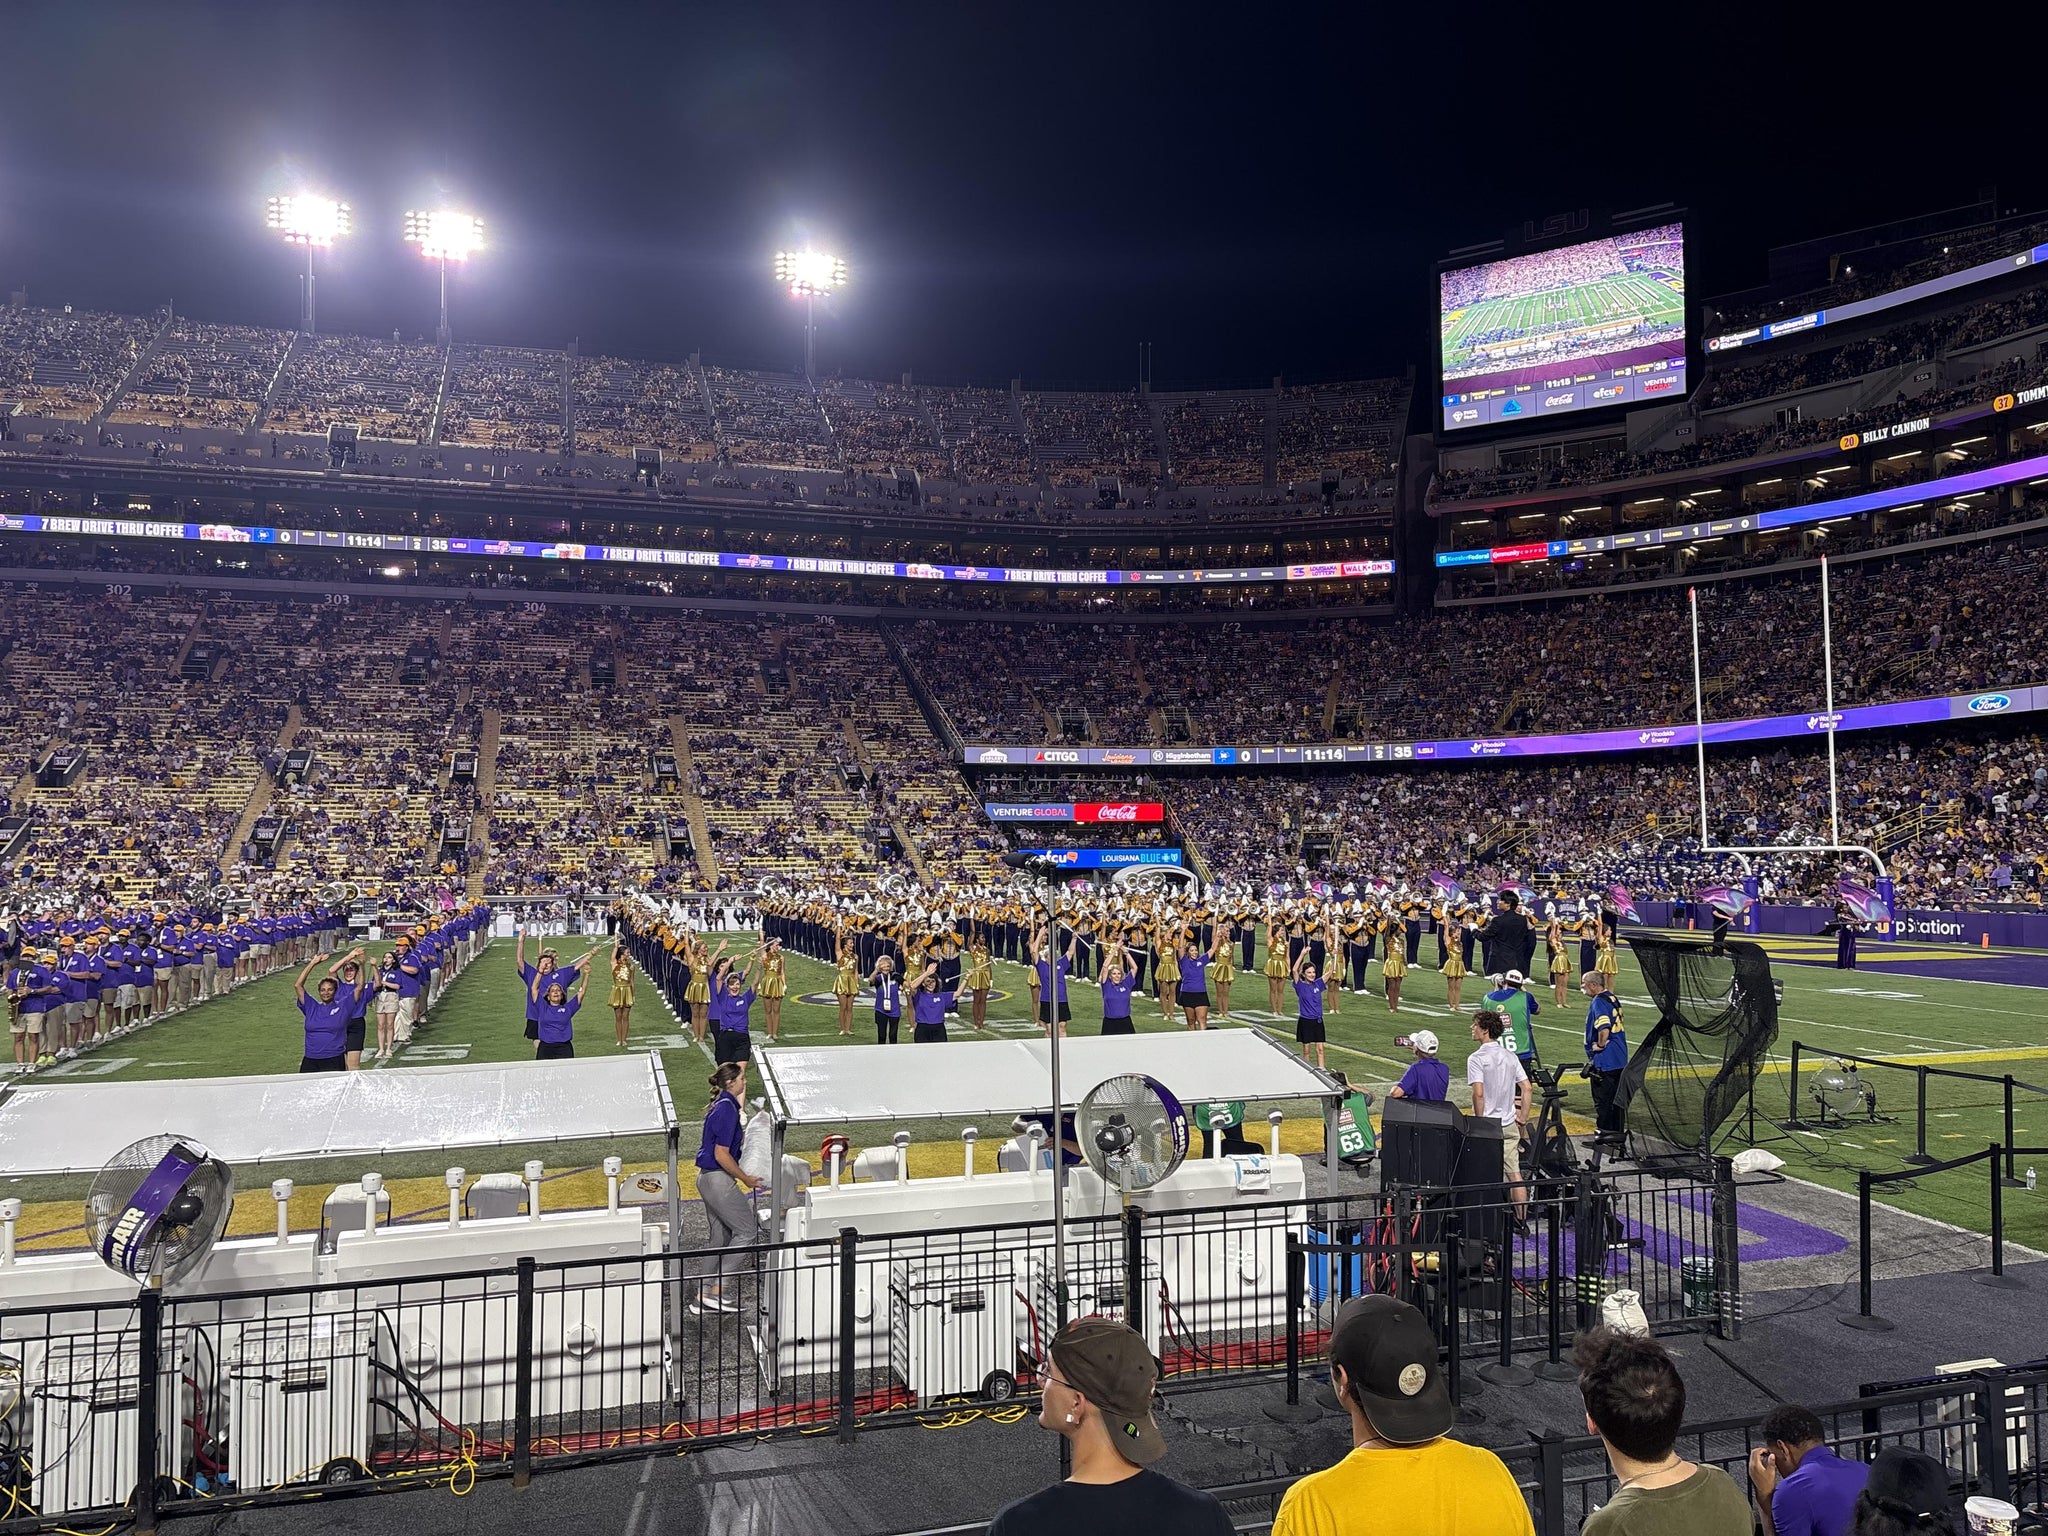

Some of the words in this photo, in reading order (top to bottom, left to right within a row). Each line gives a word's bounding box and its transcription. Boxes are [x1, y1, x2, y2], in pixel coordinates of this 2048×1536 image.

[1525, 208, 1589, 241] LSU
[1644, 376, 1678, 387] VENTURE
[1593, 387, 1616, 398] efcu
[1998, 397, 2009, 410] 37
[1863, 428, 1889, 444] BILLY
[1891, 418, 1930, 437] CANNON
[1844, 437, 1855, 448] 20
[42, 518, 50, 530] 7
[50, 519, 81, 533] BREW
[82, 521, 114, 535] DRIVE
[116, 524, 144, 537] THRU
[145, 525, 185, 538] COFFEE
[1741, 518, 1750, 529] 0
[280, 531, 290, 542] 0
[1692, 527, 1699, 536] 1
[348, 535, 382, 547] 11:14
[1644, 533, 1651, 542] 1
[413, 542, 421, 550] 2
[432, 540, 449, 551] 35
[1597, 540, 1605, 549] 2
[602, 548, 610, 559] 7
[610, 549, 635, 561] BREW
[636, 551, 662, 562] DRIVE
[663, 552, 687, 564] THRU
[688, 554, 720, 566] COFFEE
[787, 558, 794, 569] 7
[794, 559, 817, 571] BREW
[818, 560, 843, 572] DRIVE
[844, 562, 866, 574] THRU
[866, 563, 895, 576] COFFEE
[1004, 570, 1011, 580] 7
[1011, 571, 1033, 582] BREW
[1033, 571, 1056, 582] DRIVE
[1057, 572, 1078, 583] THRU
[1079, 572, 1107, 583] COFFEE
[105, 584, 132, 596] 302
[325, 593, 351, 605] 303
[524, 602, 547, 613] 304
[1977, 697, 2003, 711] Ford
[1651, 730, 1676, 738] Woodside
[1481, 741, 1507, 749] Woodside
[1652, 736, 1671, 744] Energy
[1044, 752, 1079, 762] CITGO
[1166, 752, 1211, 760] Higginbotham
[1241, 751, 1251, 762] 0
[1376, 750, 1384, 759] 2
[1394, 746, 1412, 758] 35
[993, 807, 1033, 817] VENTURE
[1034, 807, 1068, 817] GLOBAL
[1102, 854, 1140, 864] LOUISIANA
[1140, 852, 1162, 864] BLUE
[1338, 1123, 1367, 1132] MEDIA
[1340, 1132, 1365, 1153] 63
